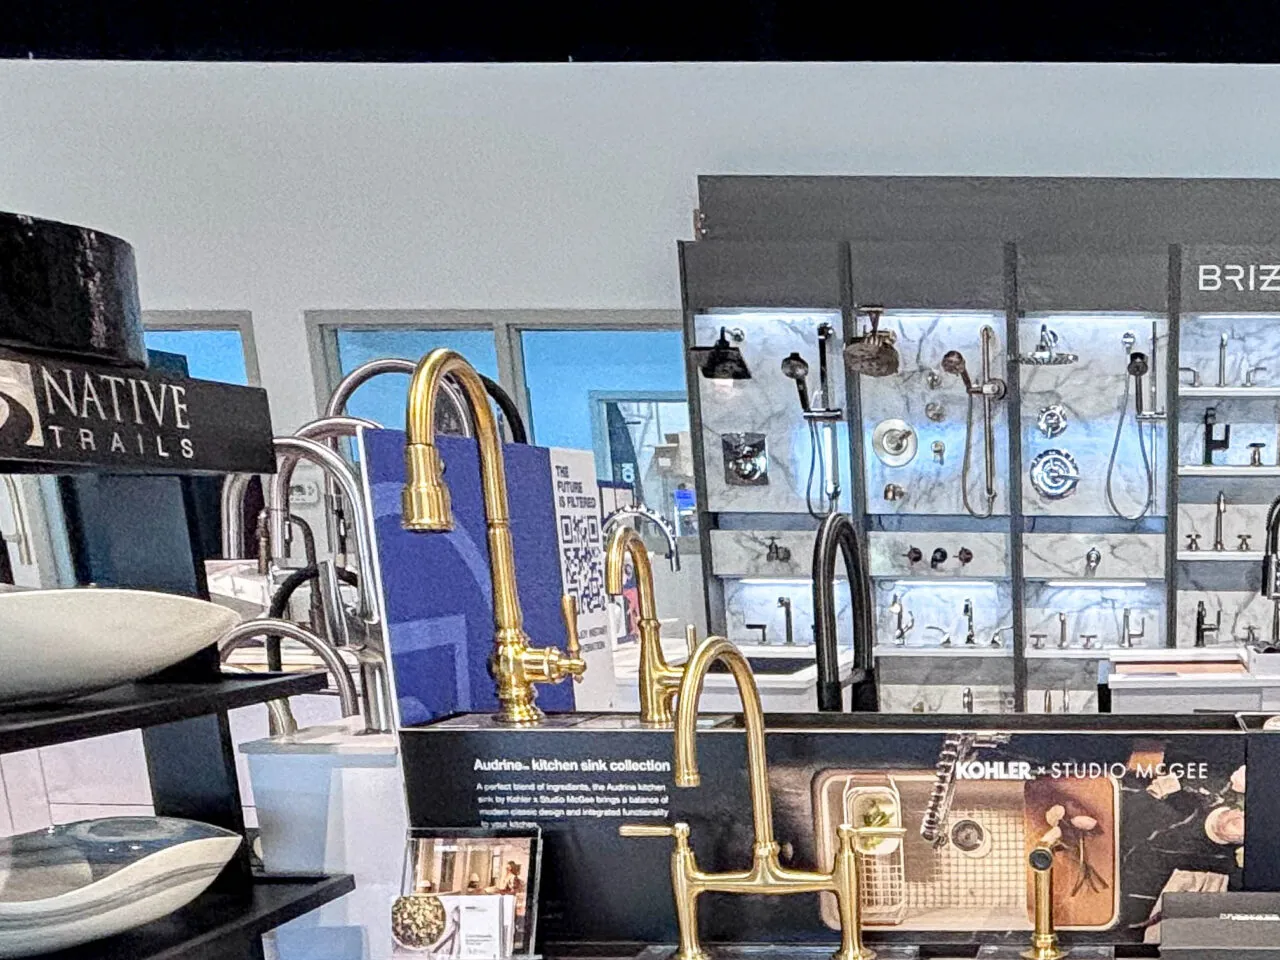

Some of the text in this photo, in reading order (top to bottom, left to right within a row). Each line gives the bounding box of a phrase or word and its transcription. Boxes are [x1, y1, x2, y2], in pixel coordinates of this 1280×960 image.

[41, 365, 190, 430] NATIVE
[48, 425, 194, 459] TRAILS
[555, 465, 569, 478] THE
[557, 481, 583, 494] FUTURE
[559, 496, 597, 508] IS FILTERED
[532, 758, 579, 772] kitchen
[581, 758, 608, 772] sink
[610, 758, 672, 772] collection
[956, 761, 1033, 780] KOHLER
[1051, 762, 1127, 780] STUDIO
